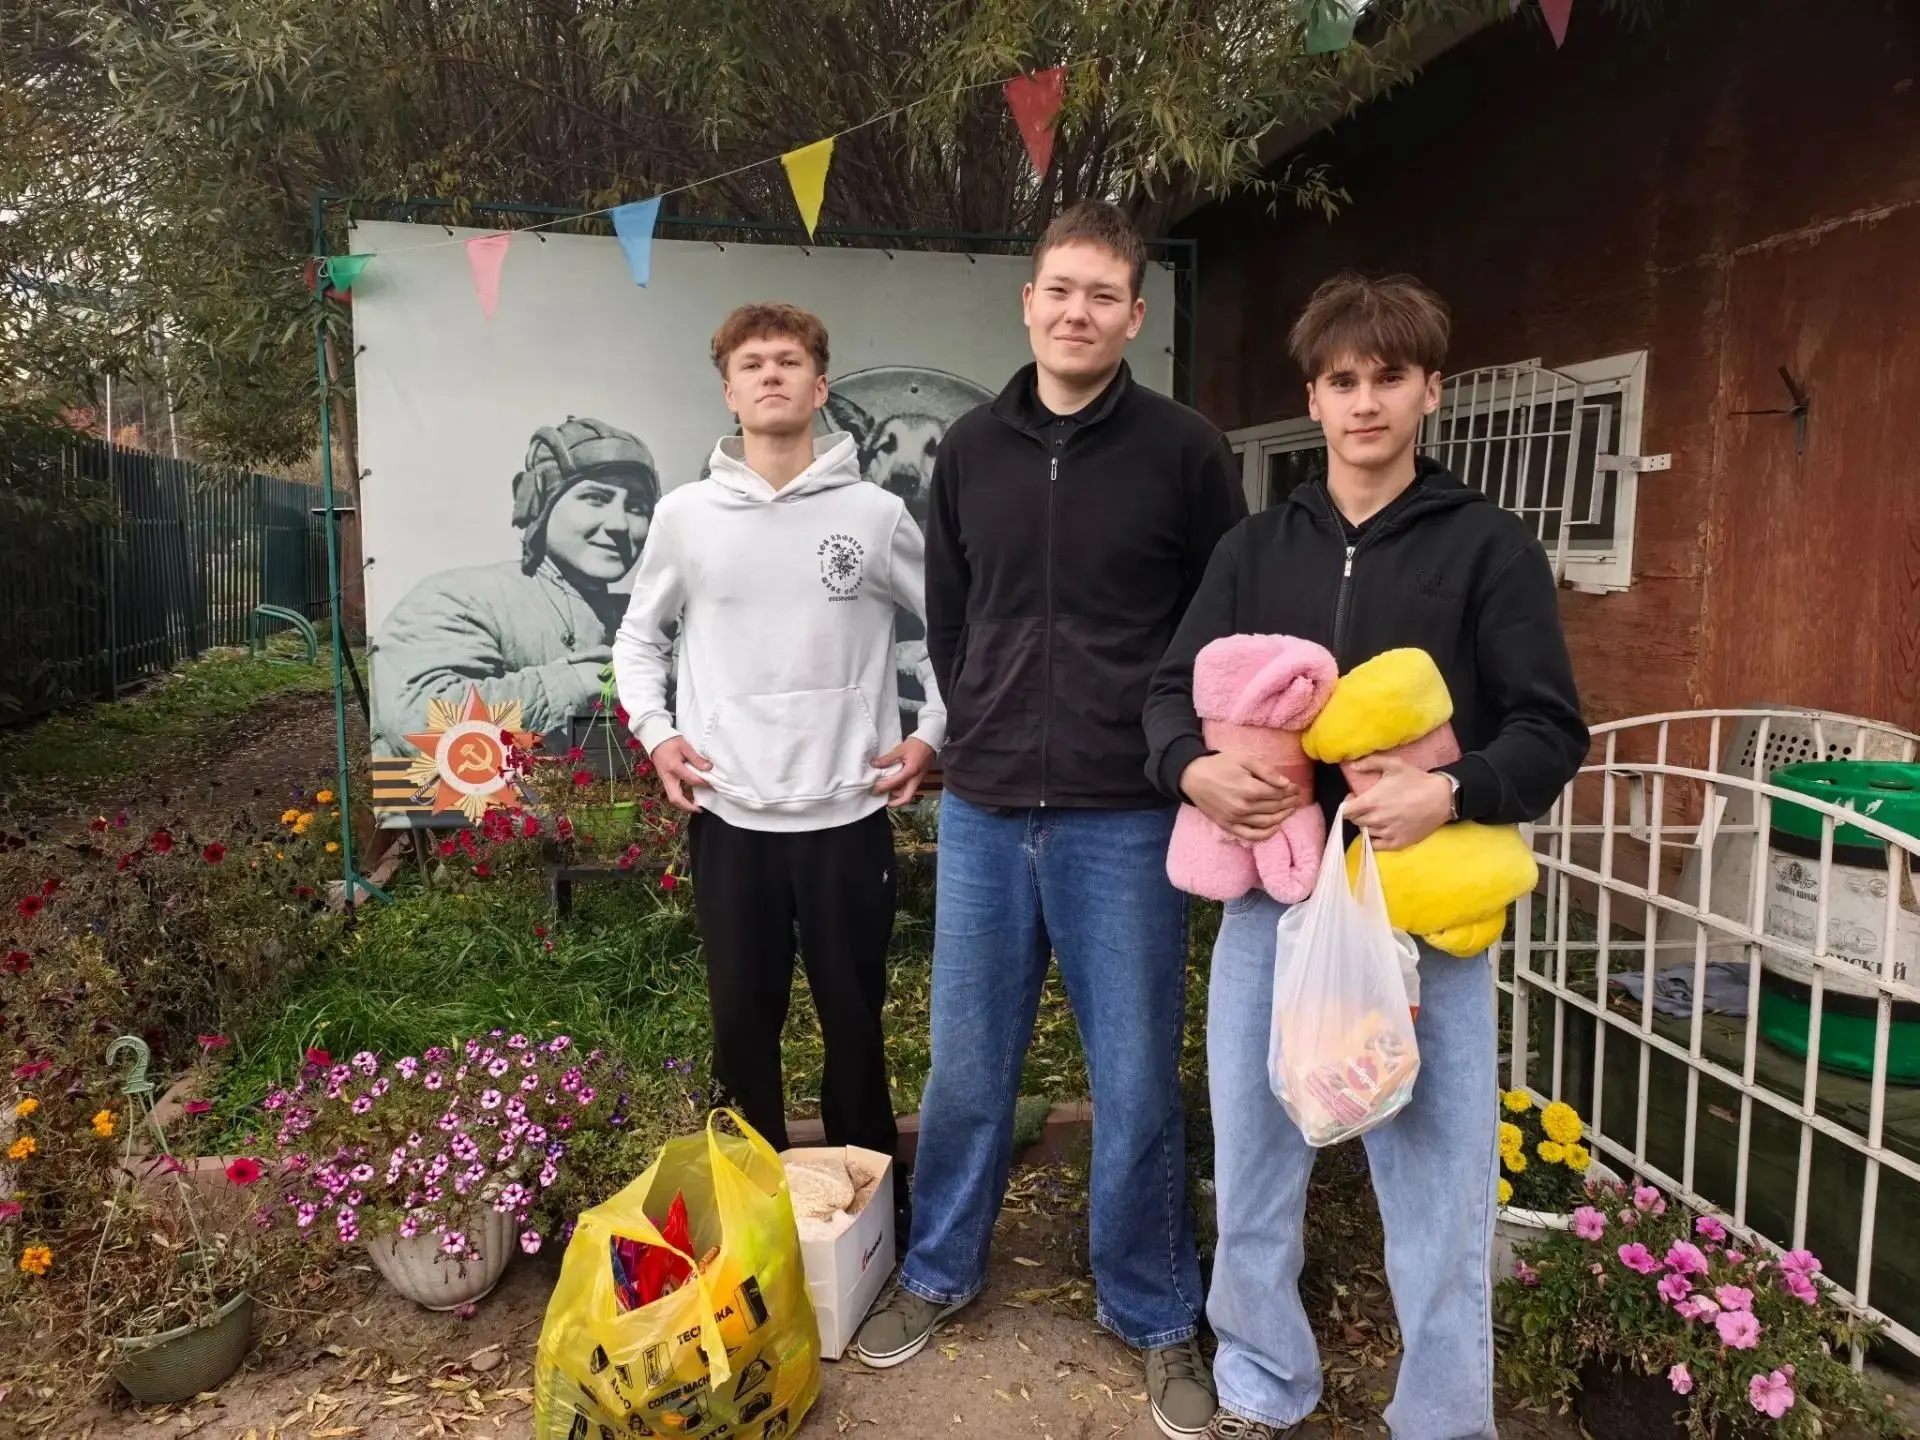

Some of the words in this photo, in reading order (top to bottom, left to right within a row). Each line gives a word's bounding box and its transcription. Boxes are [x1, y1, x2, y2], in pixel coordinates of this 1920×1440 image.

[676, 1305, 735, 1345] TECIKA
[647, 1387, 682, 1410] COFFEE
[683, 1374, 711, 1394] MACH
